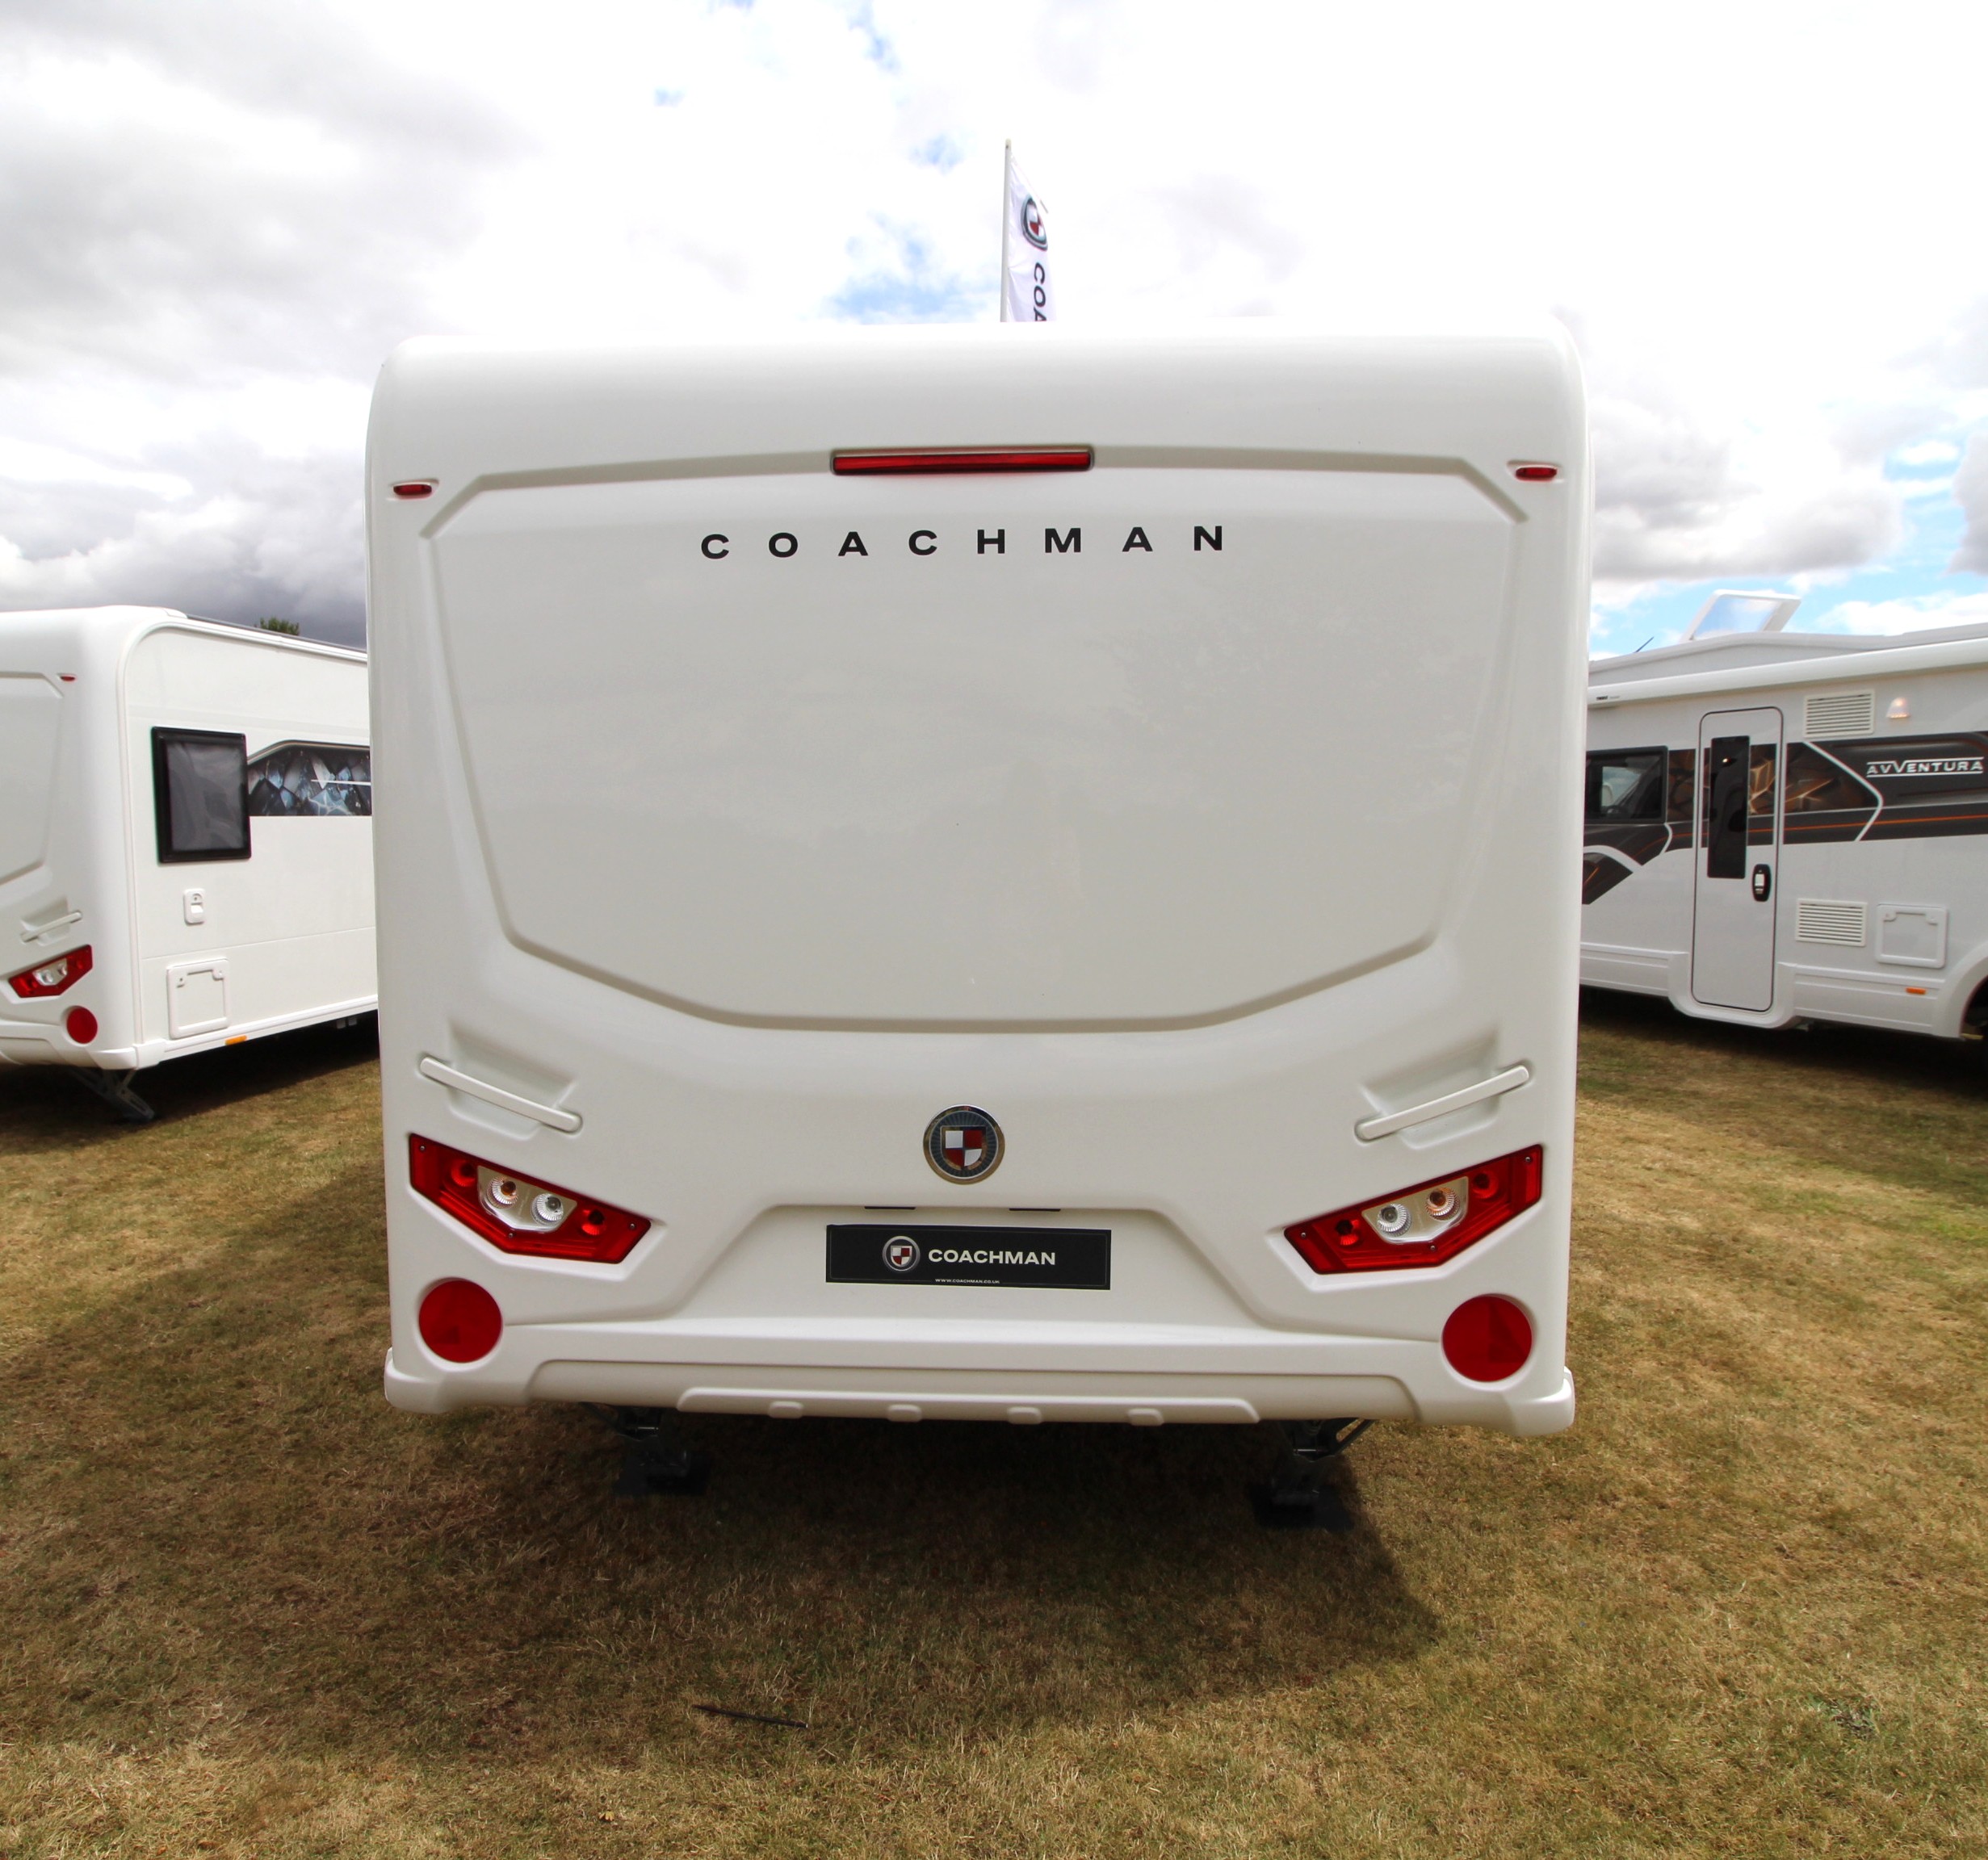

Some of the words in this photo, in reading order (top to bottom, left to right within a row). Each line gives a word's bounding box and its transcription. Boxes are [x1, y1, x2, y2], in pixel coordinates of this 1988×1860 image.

[701, 526, 1223, 559] COACHMAN
[1866, 757, 1983, 777] AVVENTURA
[928, 1249, 1055, 1266] COACHMAN
